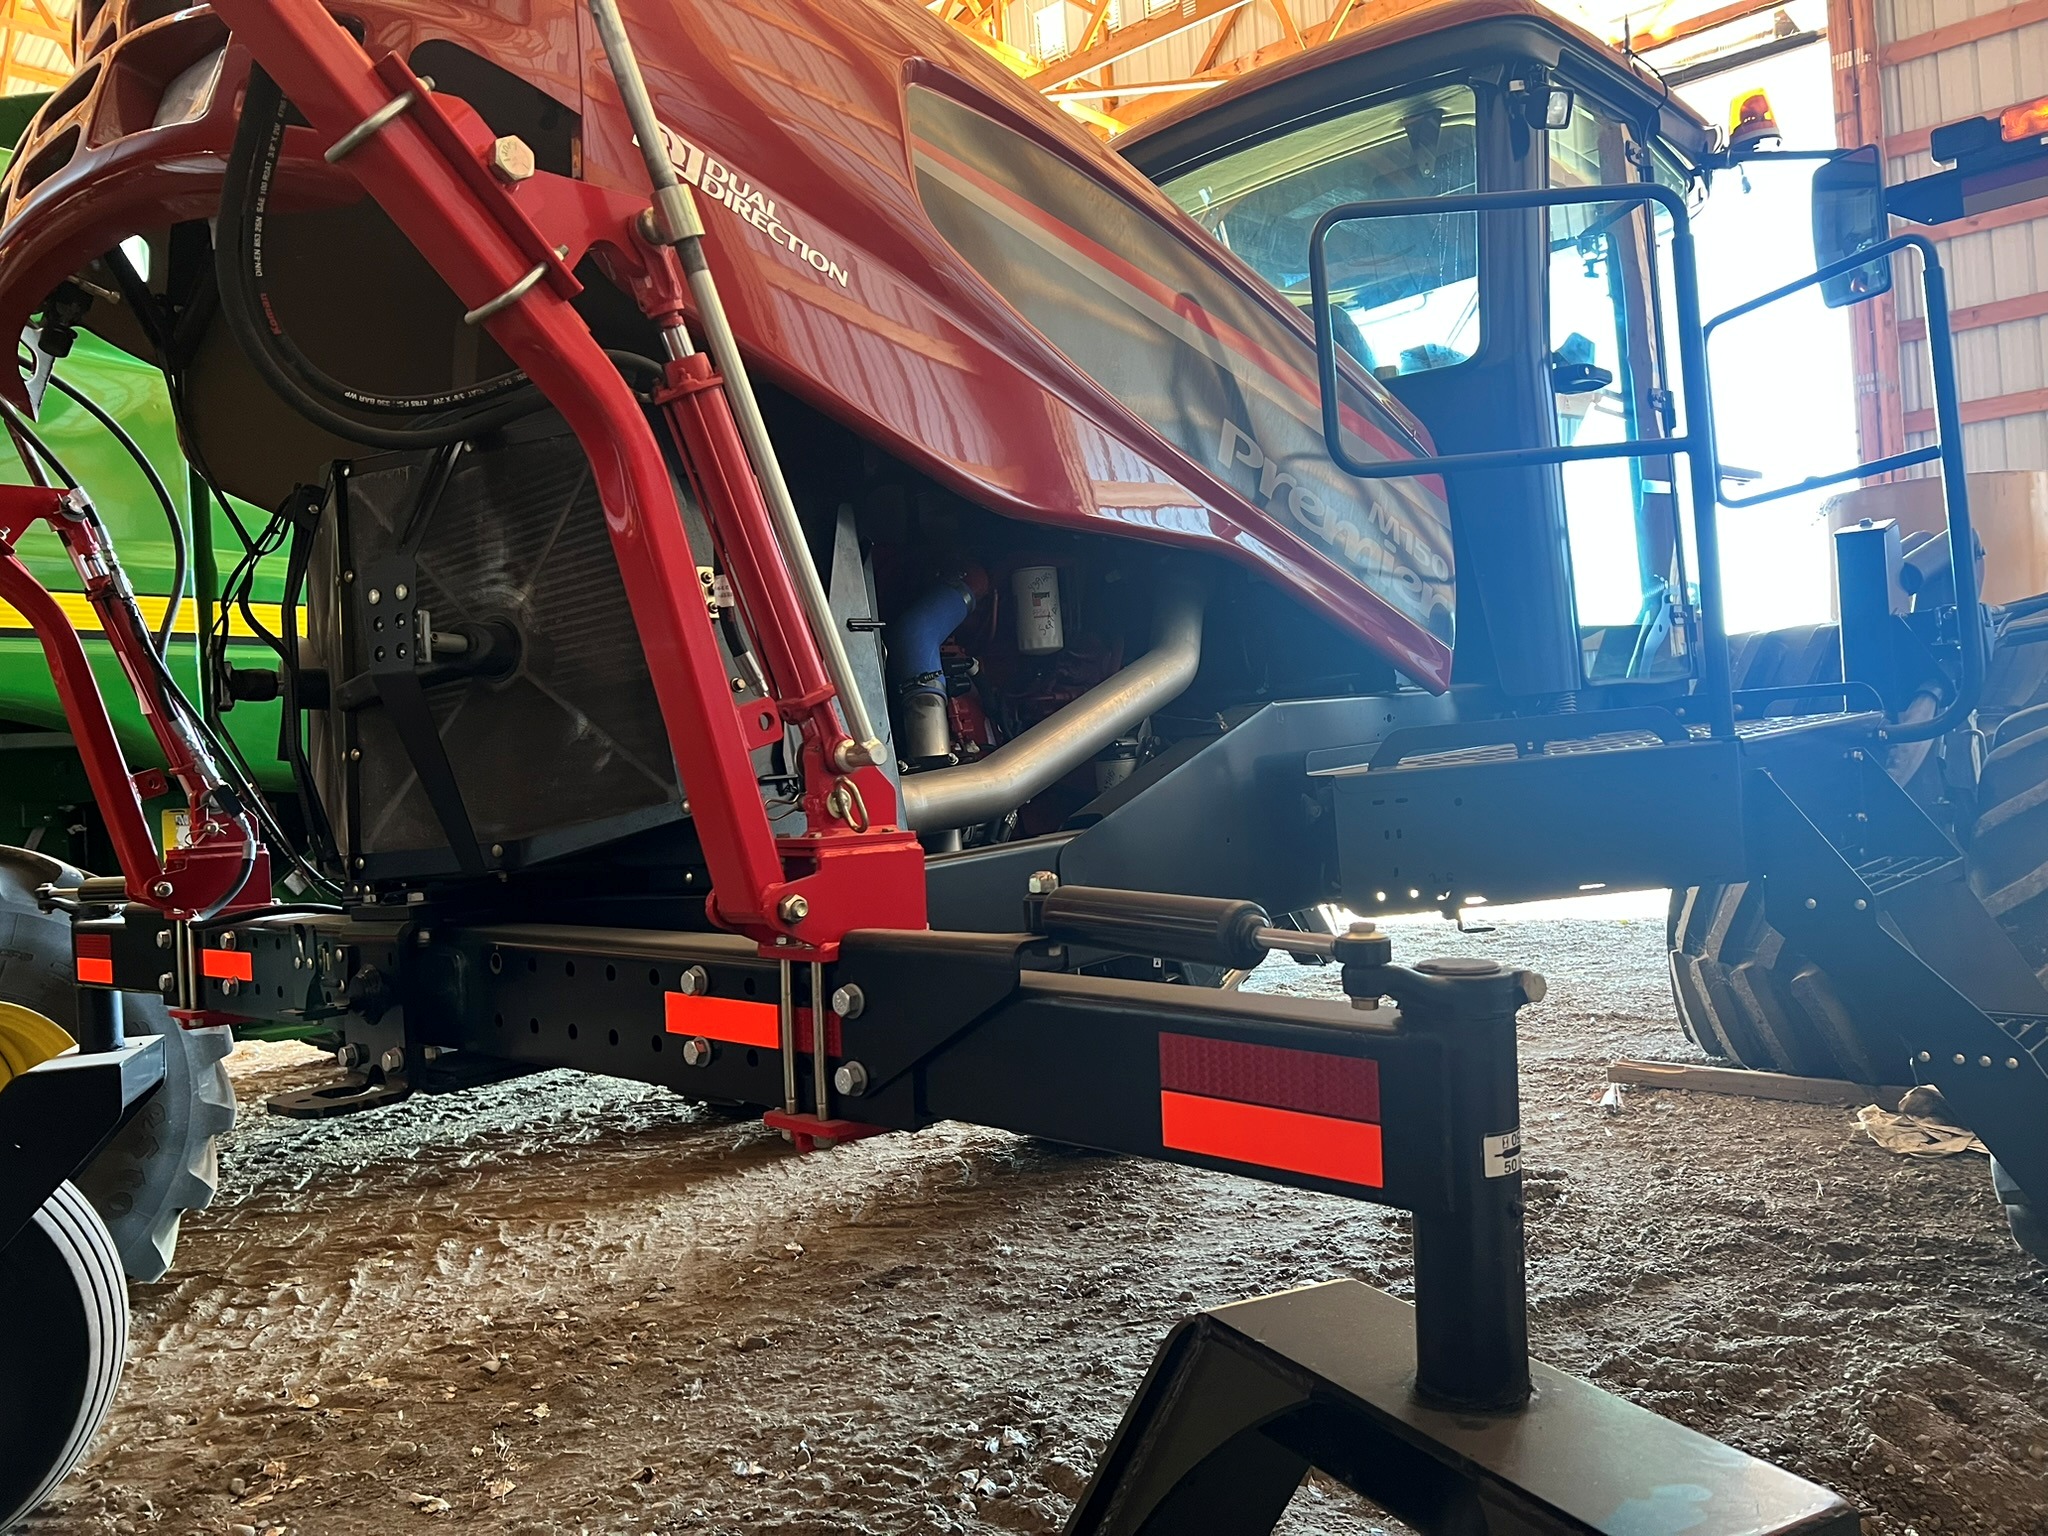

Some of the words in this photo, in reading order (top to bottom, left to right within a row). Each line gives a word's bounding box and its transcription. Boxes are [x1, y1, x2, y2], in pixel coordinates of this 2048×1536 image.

[256, 196, 265, 213] SAE
[705, 157, 782, 224] DUAL
[700, 173, 849, 288] DIRECTION
[343, 390, 358, 401] WP
[1217, 417, 1455, 620] Premier
[1367, 501, 1449, 582] M150
[1504, 1158, 1517, 1173] 50
